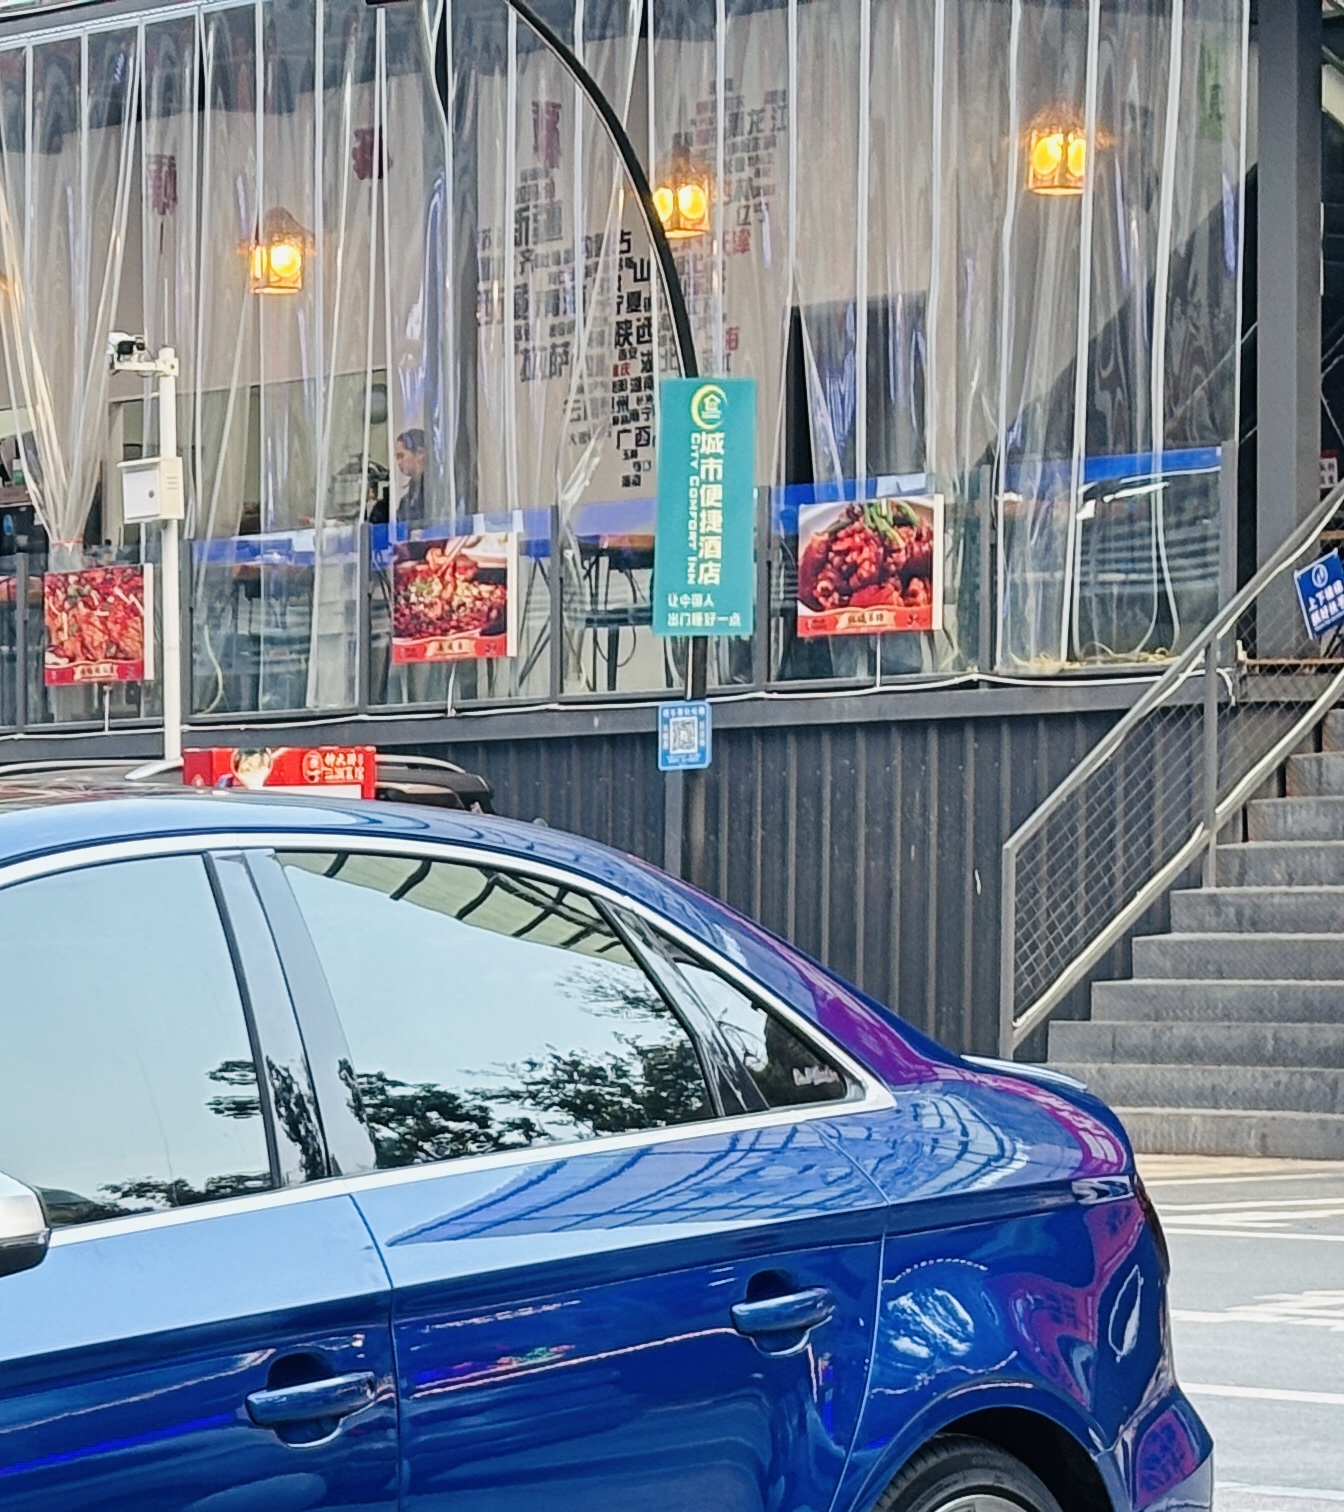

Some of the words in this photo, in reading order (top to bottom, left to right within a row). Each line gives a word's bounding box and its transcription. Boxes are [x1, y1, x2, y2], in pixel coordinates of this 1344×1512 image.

[698, 431, 725, 586] 城市便捷酒店
